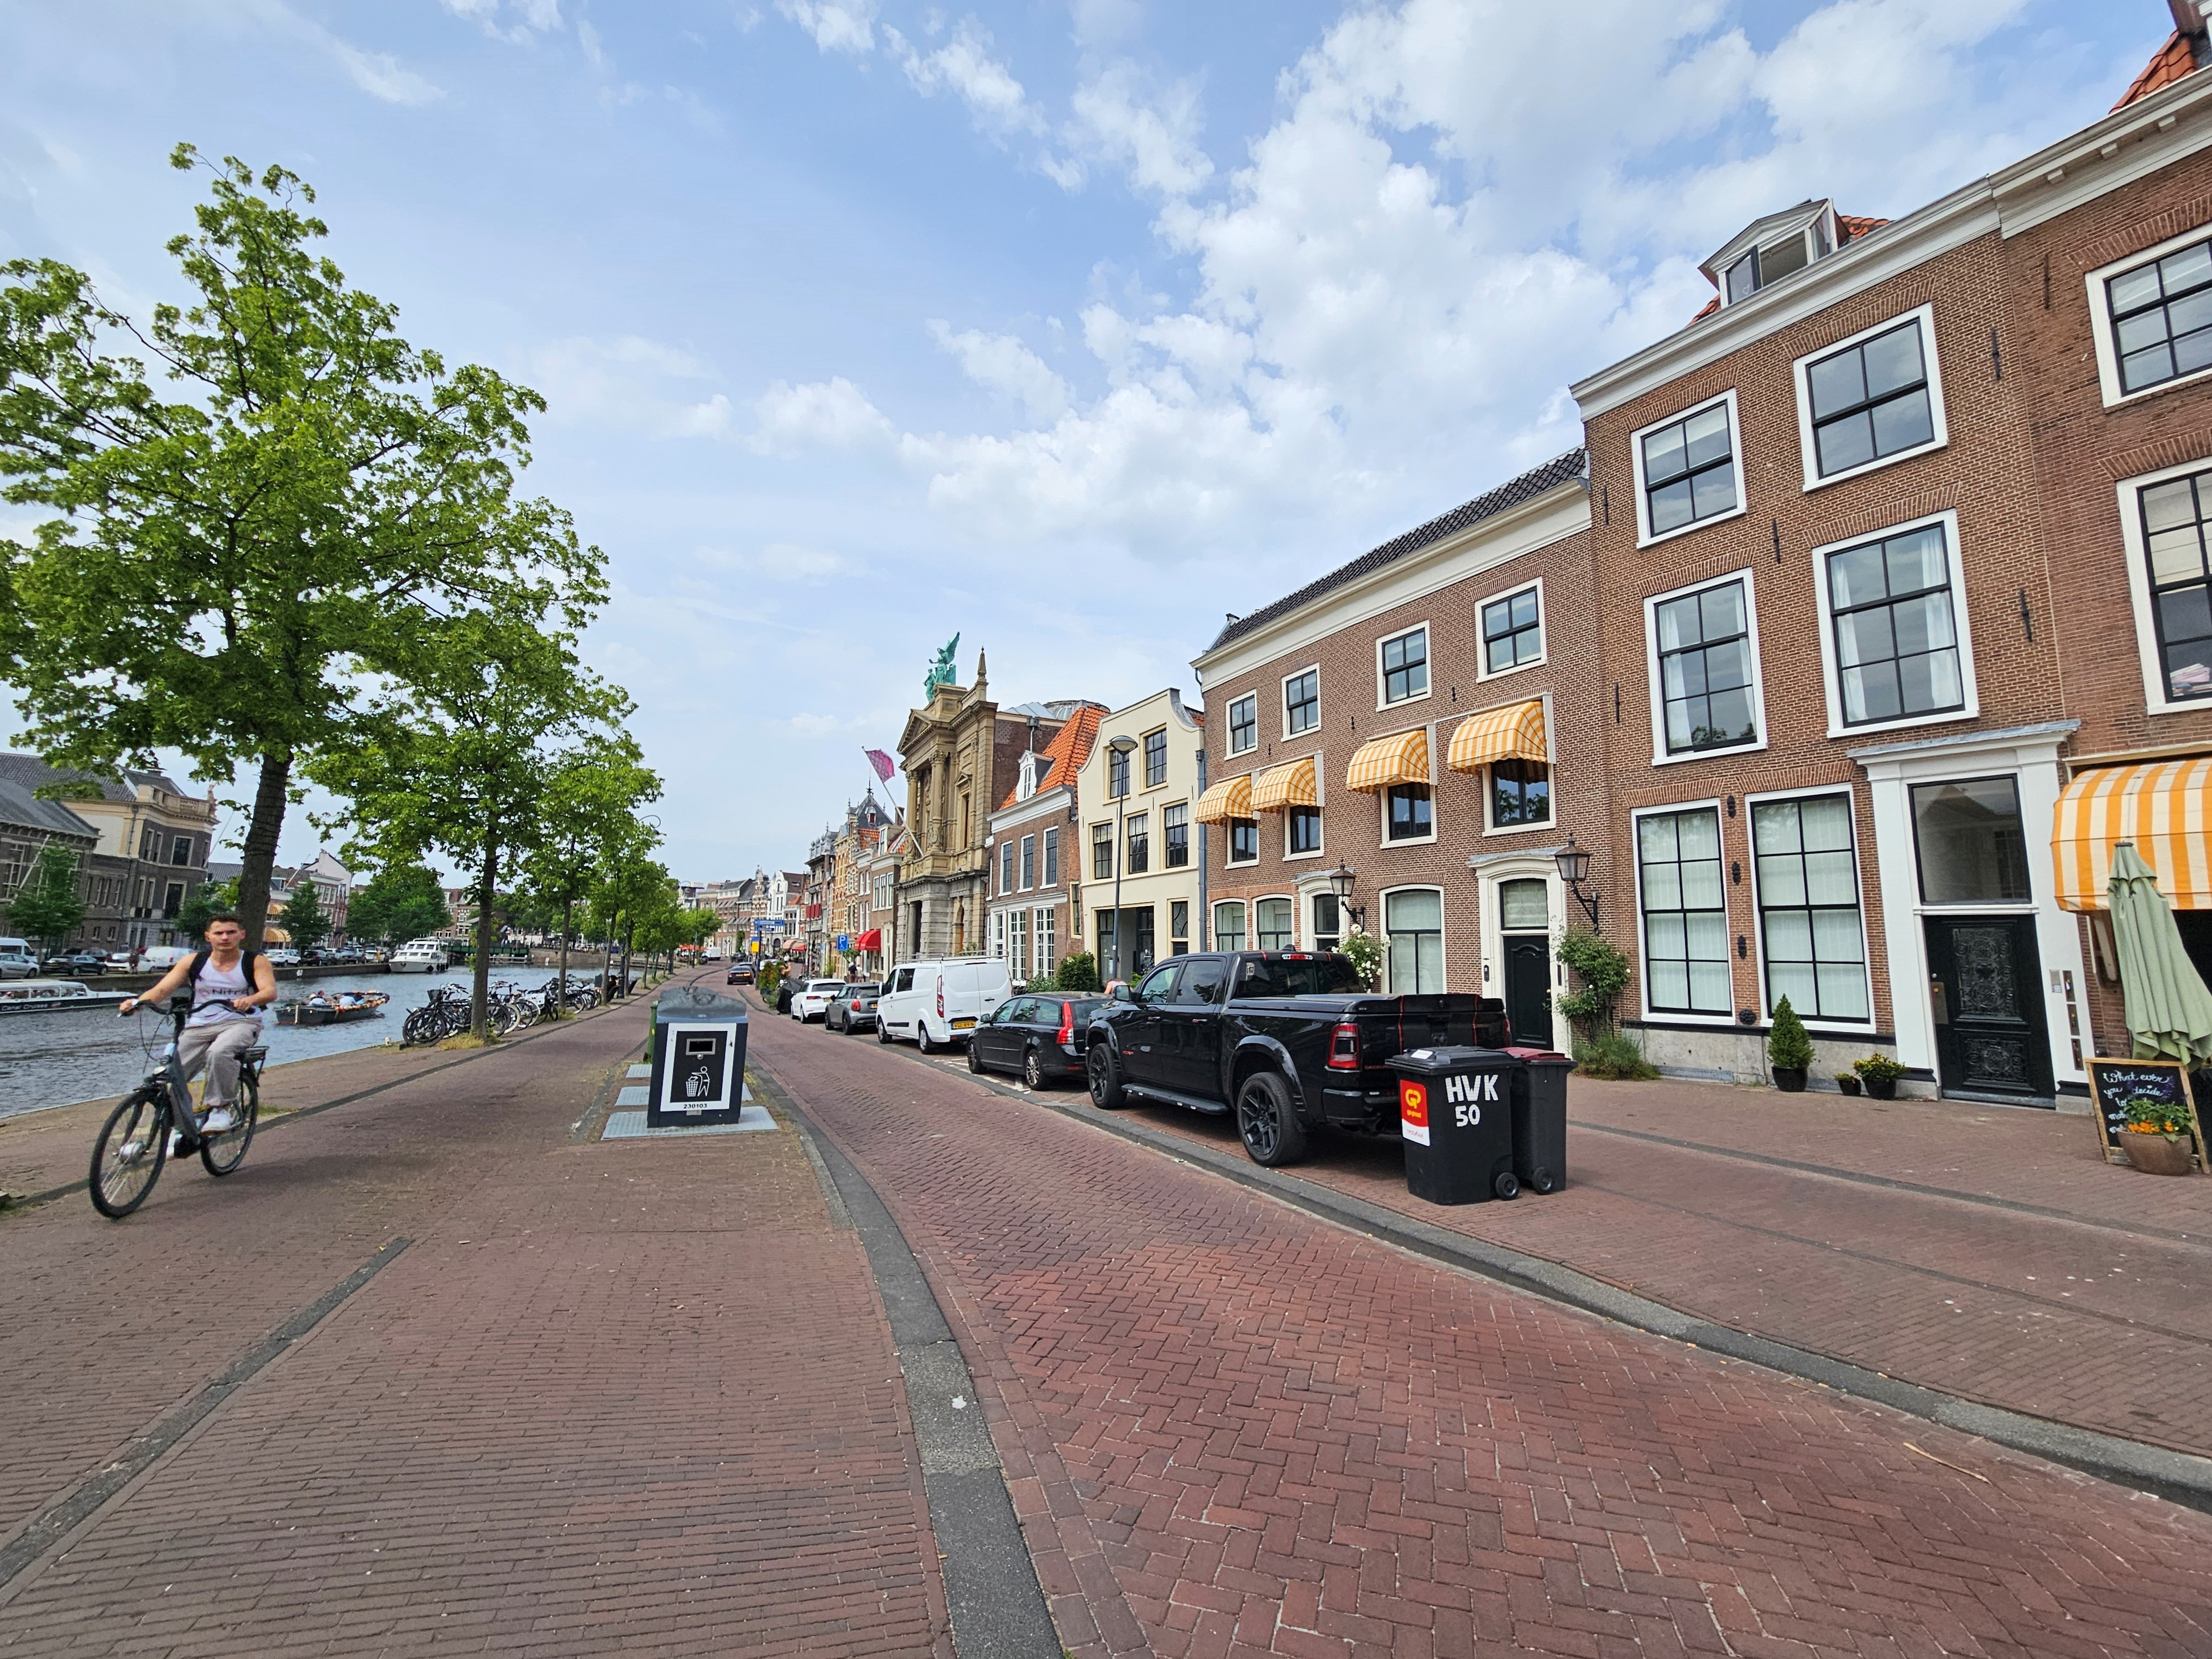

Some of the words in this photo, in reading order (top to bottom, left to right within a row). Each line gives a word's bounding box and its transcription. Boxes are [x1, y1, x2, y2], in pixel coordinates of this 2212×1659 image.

[2103, 1070, 2138, 1083] What
[2140, 1074, 2170, 1083] ever
[2104, 1087, 2122, 1099] you
[2132, 1086, 2163, 1096] decide
[1455, 1104, 1480, 1126] 50
